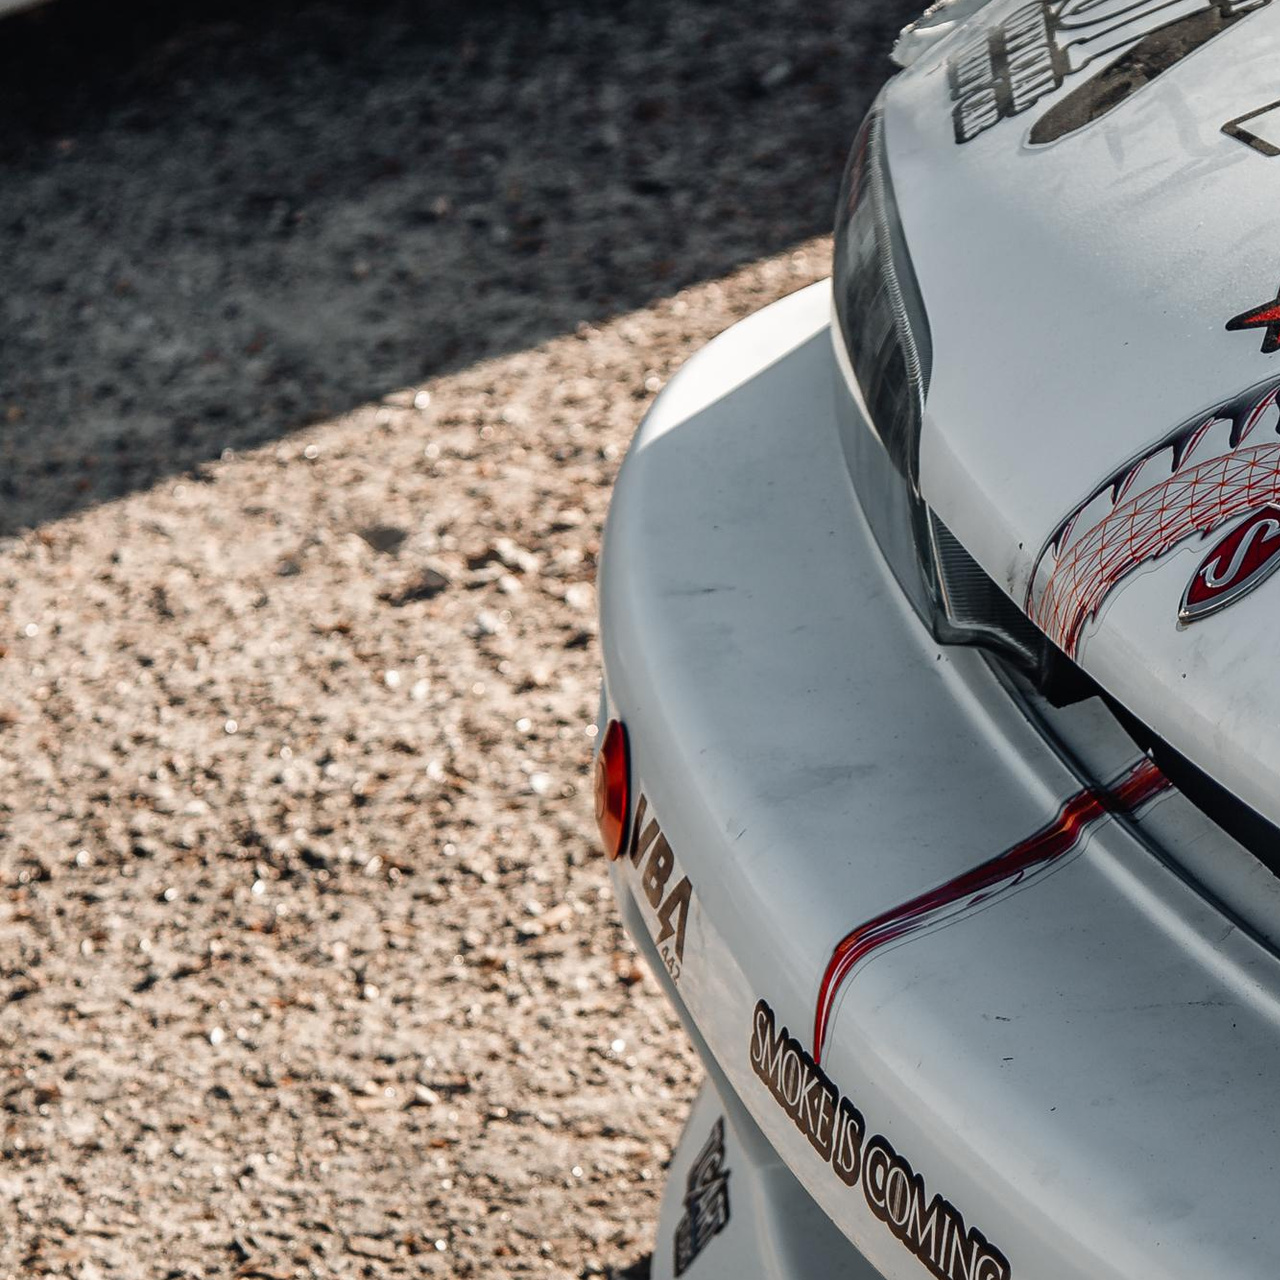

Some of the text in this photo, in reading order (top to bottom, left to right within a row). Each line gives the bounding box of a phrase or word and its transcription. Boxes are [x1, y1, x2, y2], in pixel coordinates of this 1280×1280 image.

[1005, 2, 1058, 112] OFFICIAL
[753, 1007, 832, 1152] SMOKE
[833, 1109, 861, 1178] IS
